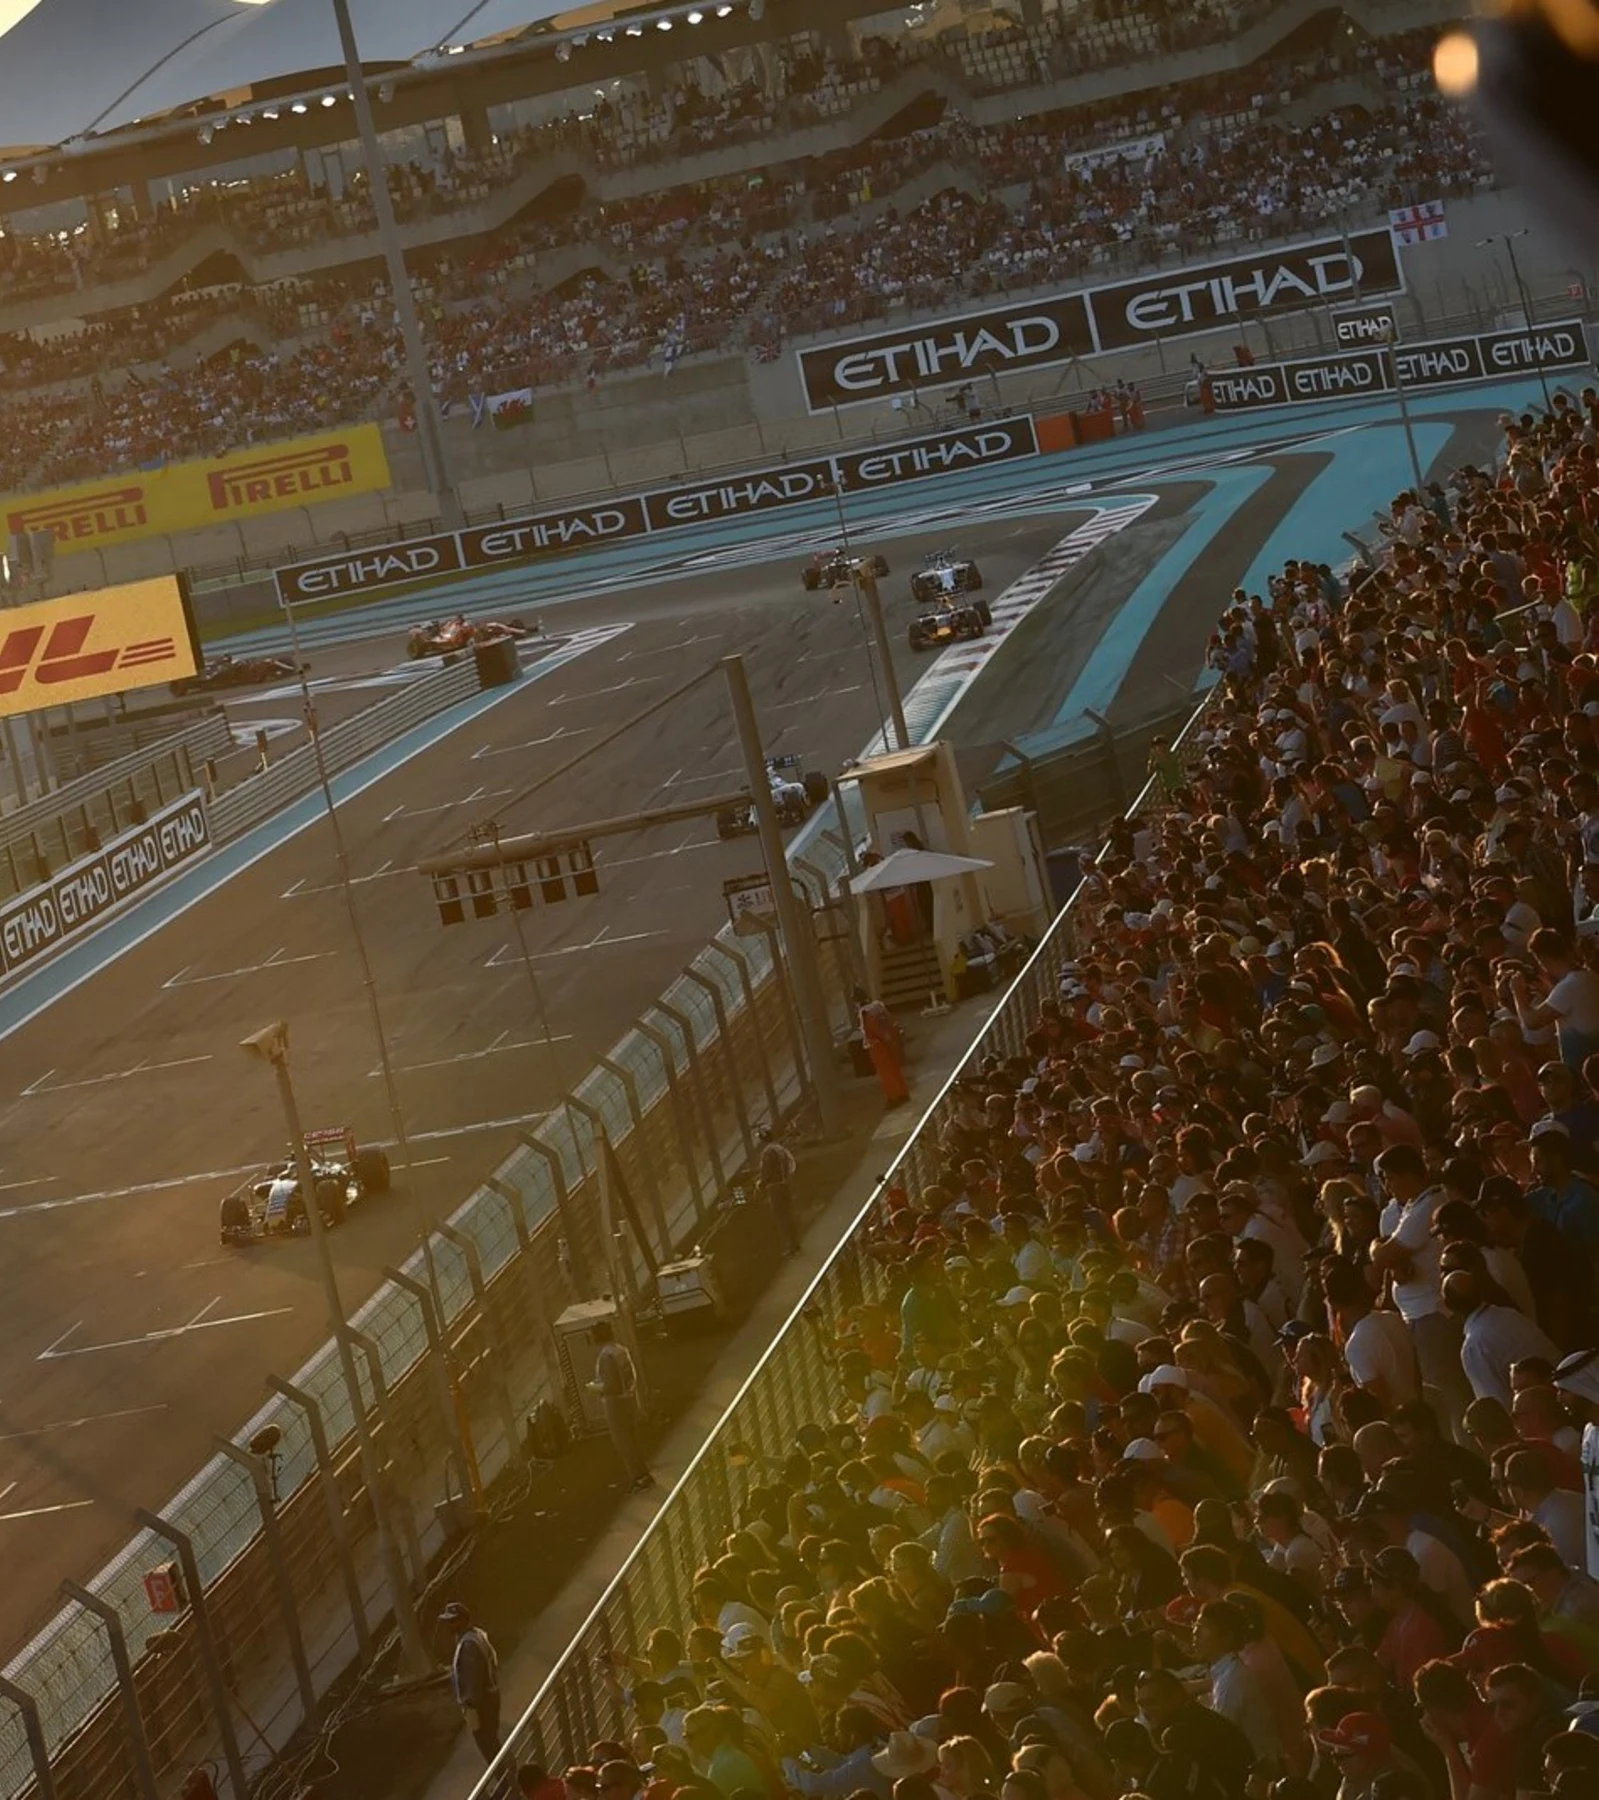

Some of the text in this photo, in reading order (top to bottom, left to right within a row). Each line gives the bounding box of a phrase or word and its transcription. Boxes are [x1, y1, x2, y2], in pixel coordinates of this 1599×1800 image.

[1124, 252, 1362, 331] ETIHAD
[834, 316, 1060, 390] ETIHAD
[1338, 315, 1394, 341] ETIHAD
[1492, 332, 1575, 366] ETIHAD
[1295, 362, 1372, 393] ETIHAD
[1396, 348, 1470, 381] ETIHAD
[207, 443, 353, 510] PIRELLI
[857, 431, 1013, 483] ETIHAD
[6, 486, 148, 543] PRELLI
[665, 471, 816, 520] ETIHAD
[479, 509, 627, 555] ETIHAD
[297, 546, 441, 591] ETIHAD
[160, 807, 205, 860] ETIHAD
[111, 835, 158, 891] ETIHAD
[58, 866, 109, 924] ETIHAD
[3, 899, 57, 958] ETIHAD
